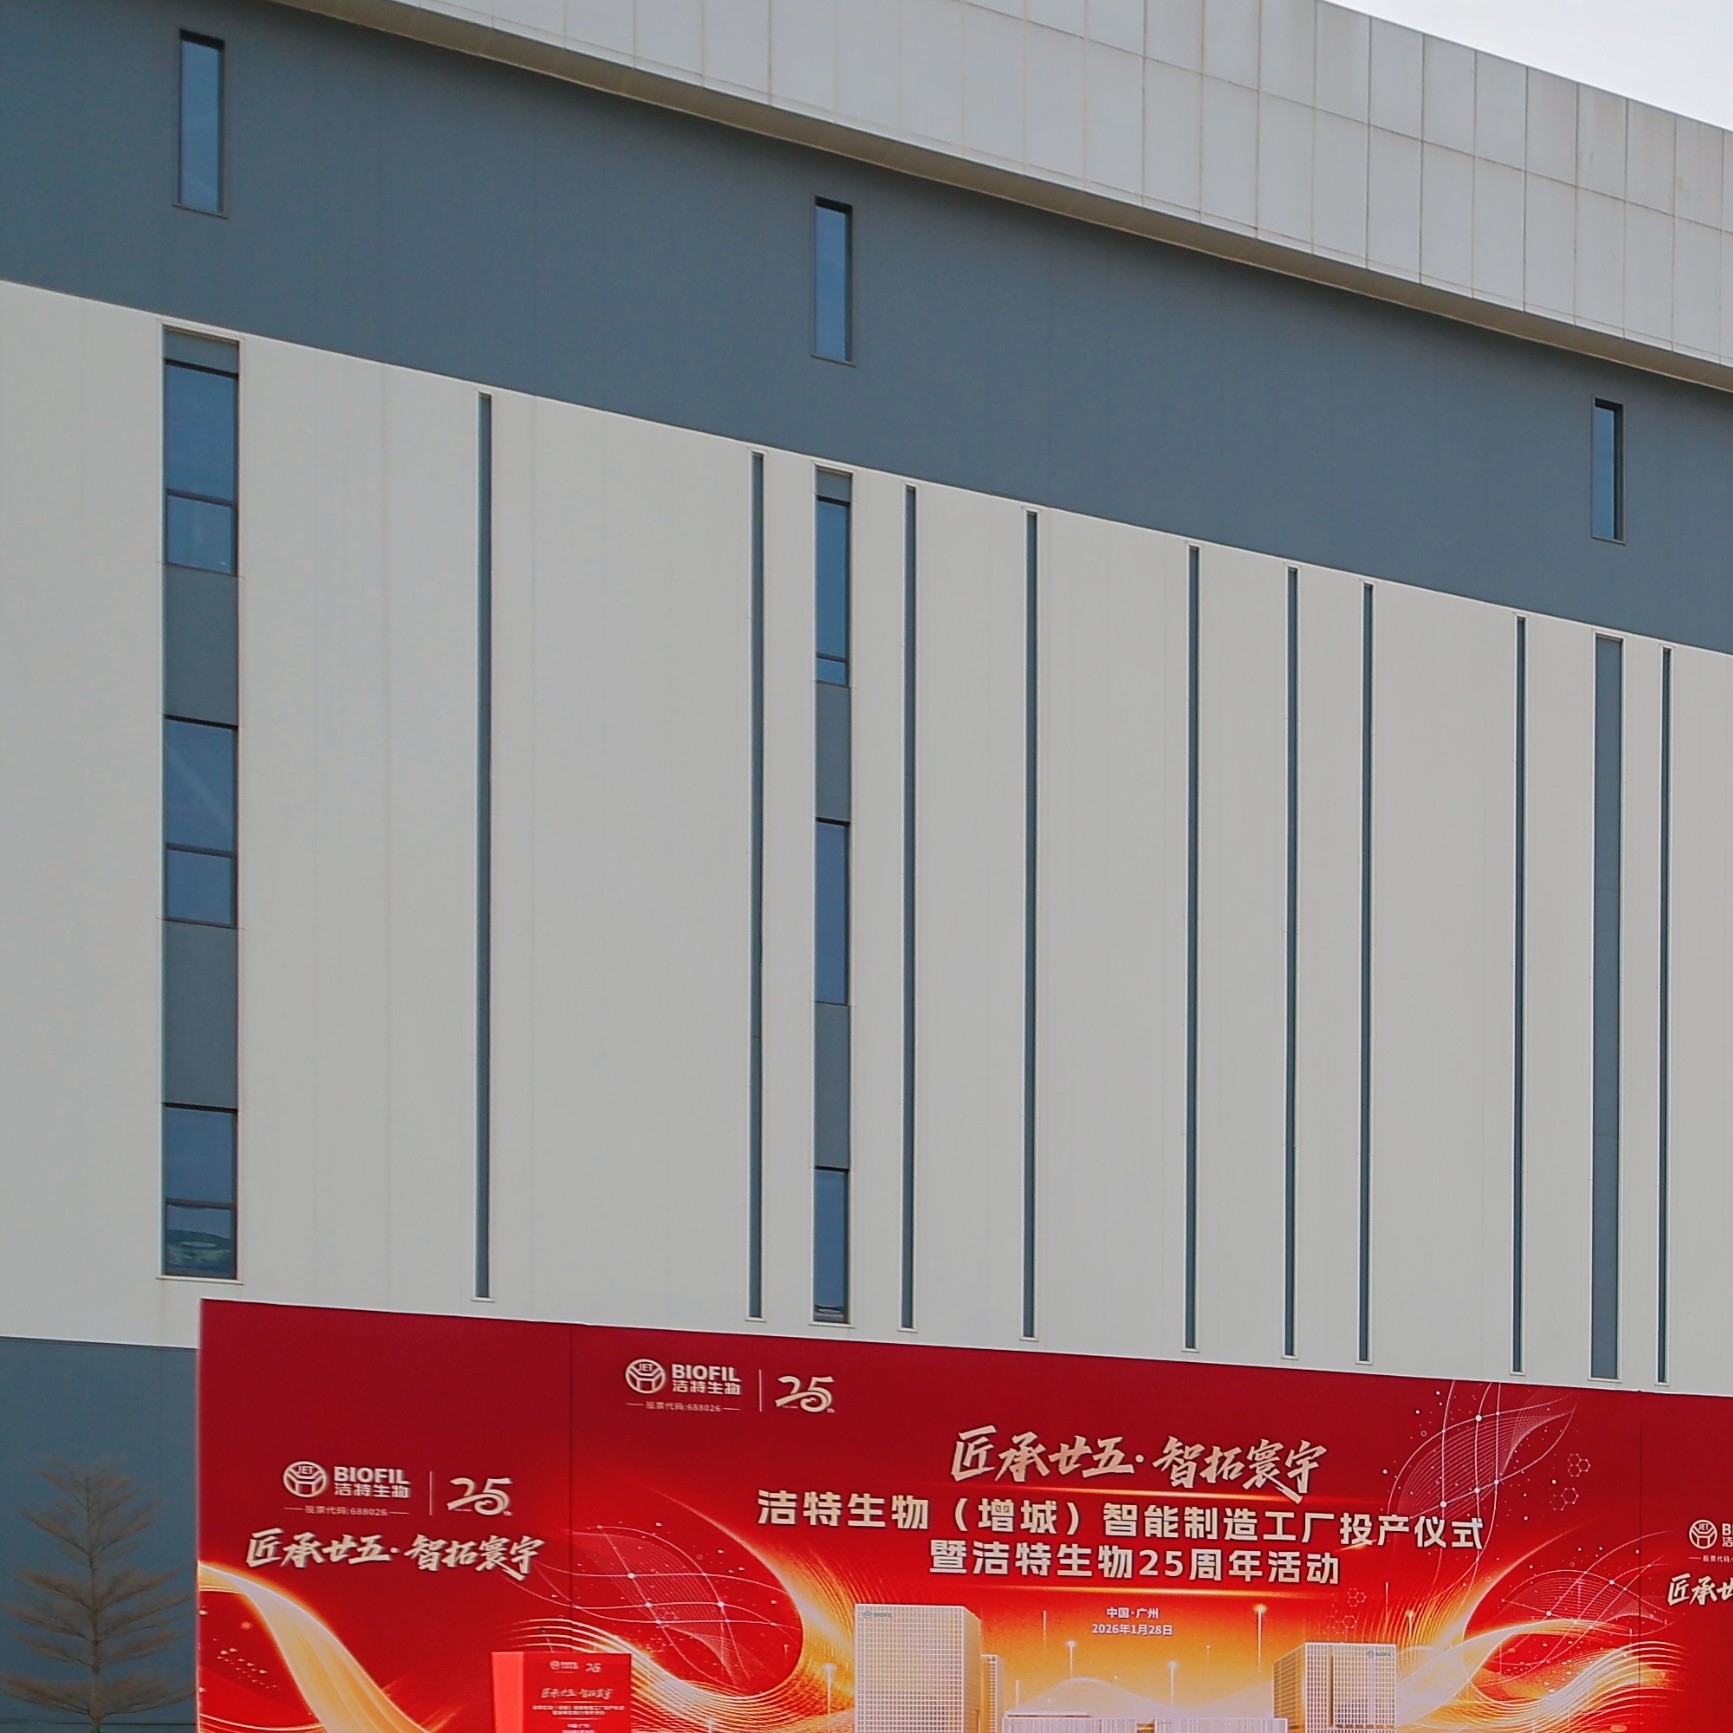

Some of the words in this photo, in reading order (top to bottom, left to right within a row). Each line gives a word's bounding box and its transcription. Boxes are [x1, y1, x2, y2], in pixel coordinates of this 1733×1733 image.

[671, 1363, 742, 1383] BIOFIL
[671, 1380, 741, 1396] 洁特生物
[333, 1465, 411, 1485] BIOFIL
[333, 1483, 411, 1499] 洁特生物
[929, 1539, 1340, 1585] 暨洁特生物25周年活动
[1091, 1622, 1174, 1637] 2026年1月28日
